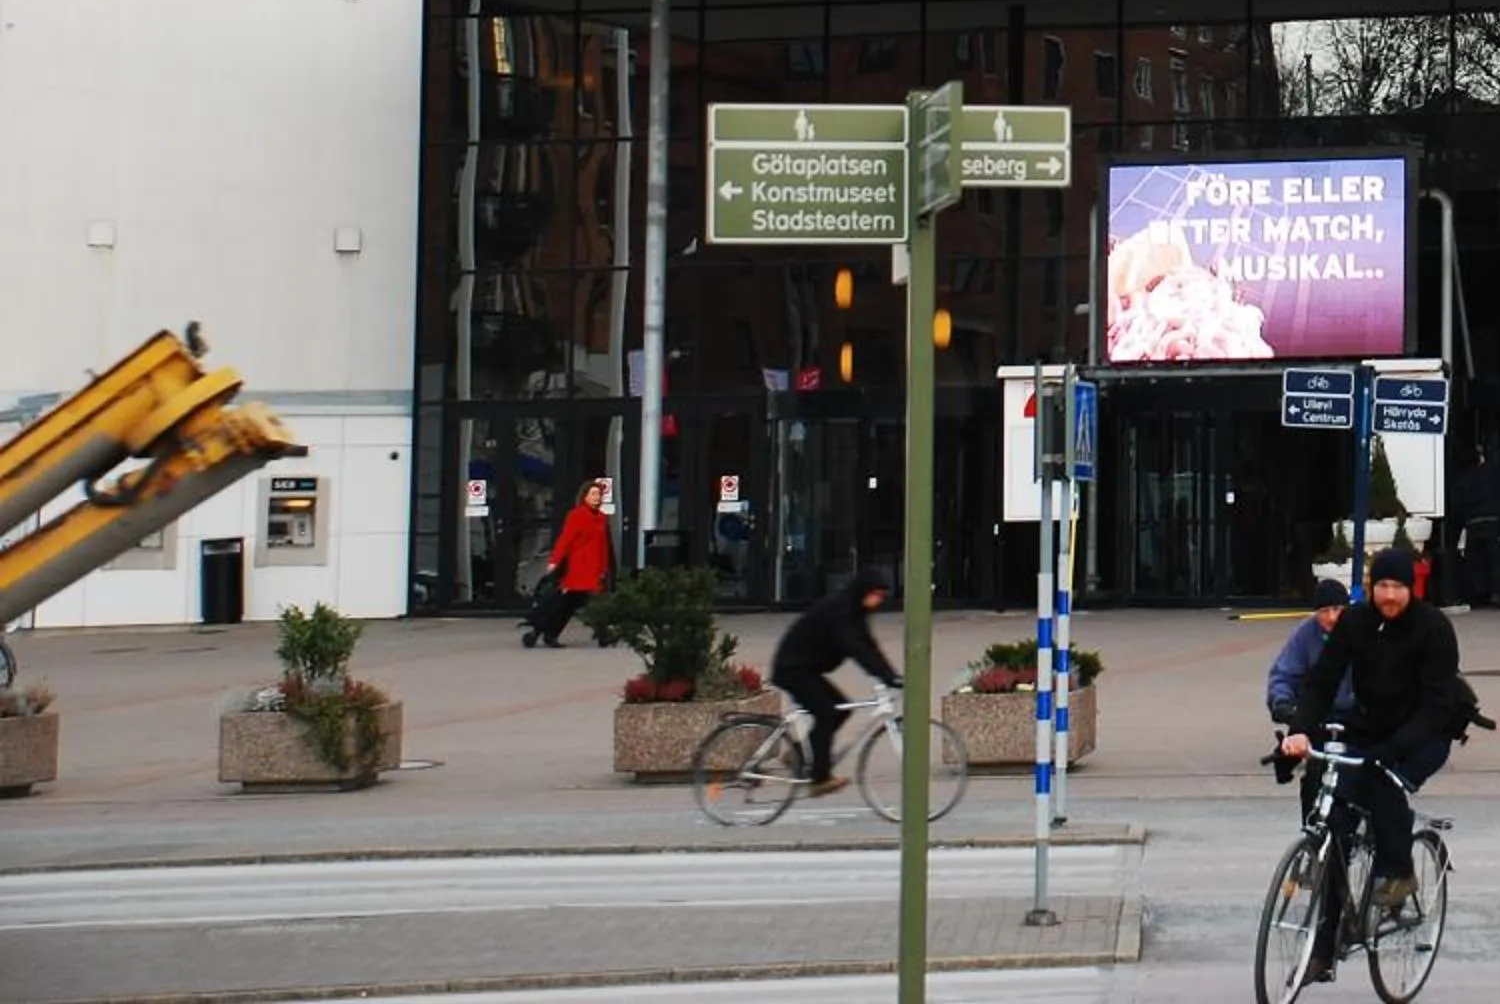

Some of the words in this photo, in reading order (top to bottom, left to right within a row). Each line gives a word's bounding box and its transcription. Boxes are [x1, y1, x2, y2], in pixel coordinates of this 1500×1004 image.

[751, 153, 887, 180] Götaplatsen
[961, 154, 1027, 181] seberg
[751, 182, 896, 203] Konstmuseet
[1186, 173, 1271, 206] FÖRE
[1283, 176, 1385, 203] ELLER
[751, 209, 895, 232] Stadsteatern
[1262, 214, 1385, 244] MATCH,
[1301, 411, 1348, 424] Centrum
